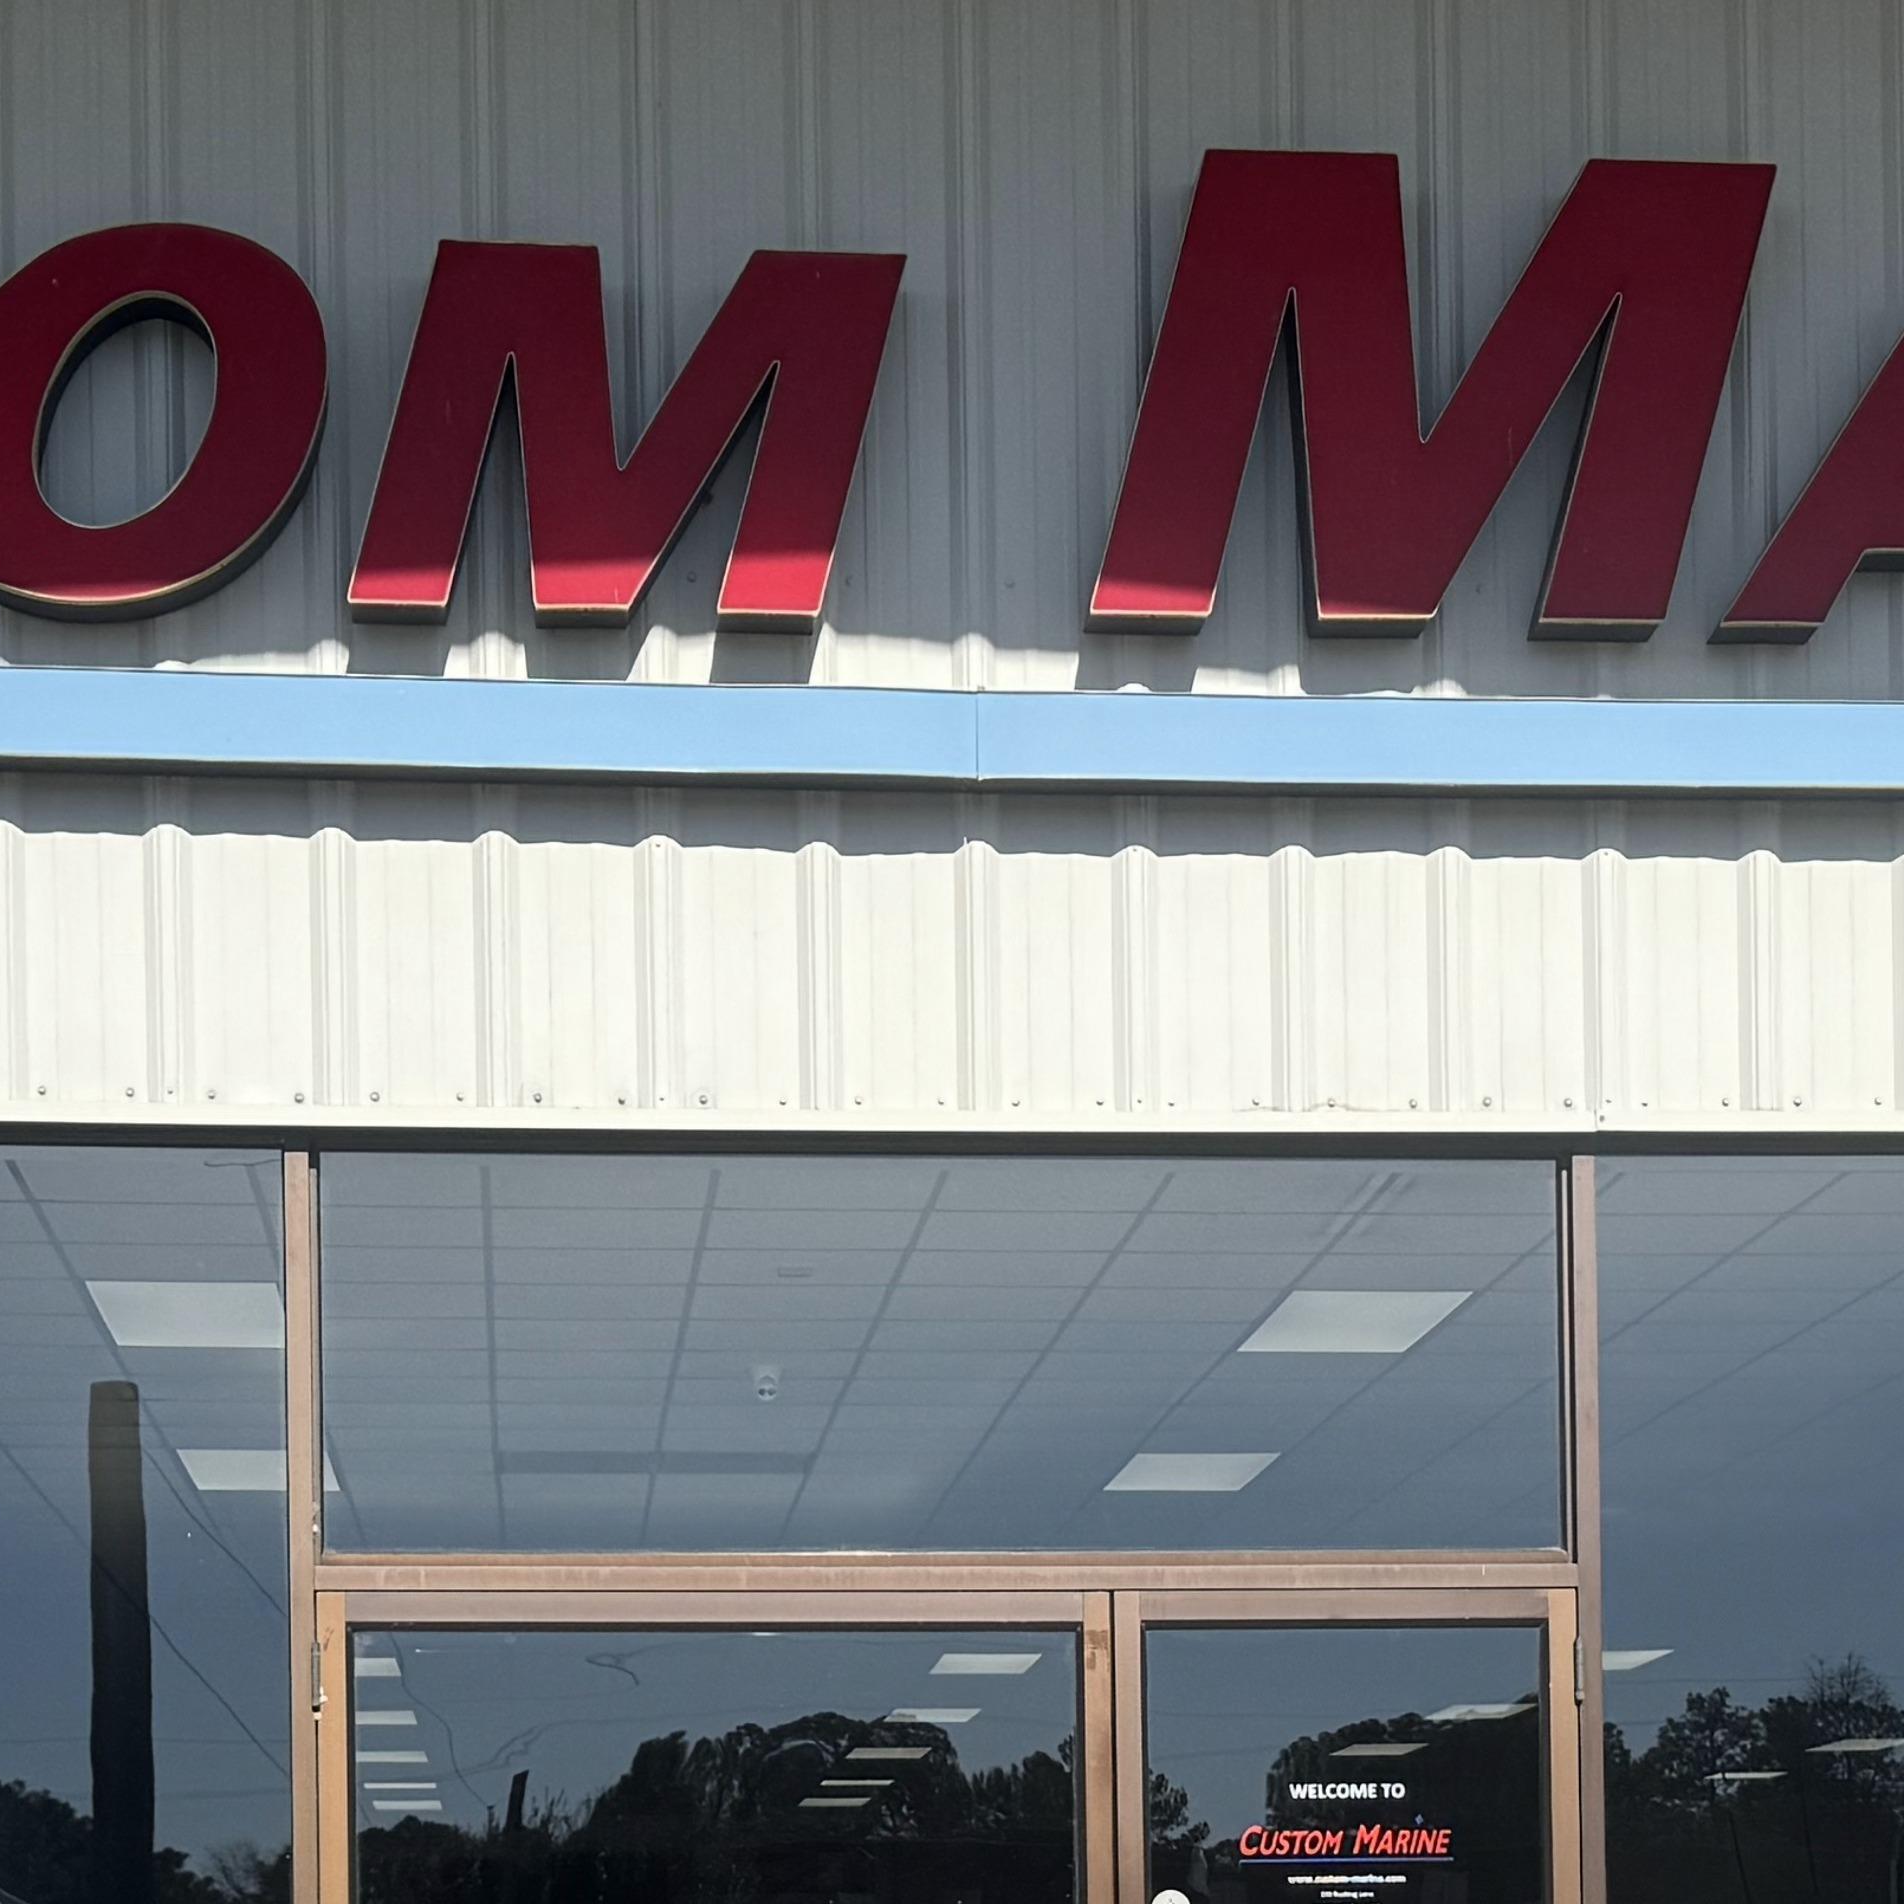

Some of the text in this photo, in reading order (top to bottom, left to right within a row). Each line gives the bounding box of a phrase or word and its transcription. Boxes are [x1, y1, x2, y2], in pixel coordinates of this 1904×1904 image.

[1289, 1783, 1406, 1799] WELCOME TO
[1239, 1823, 1452, 1856] CUSTOM MARINE
